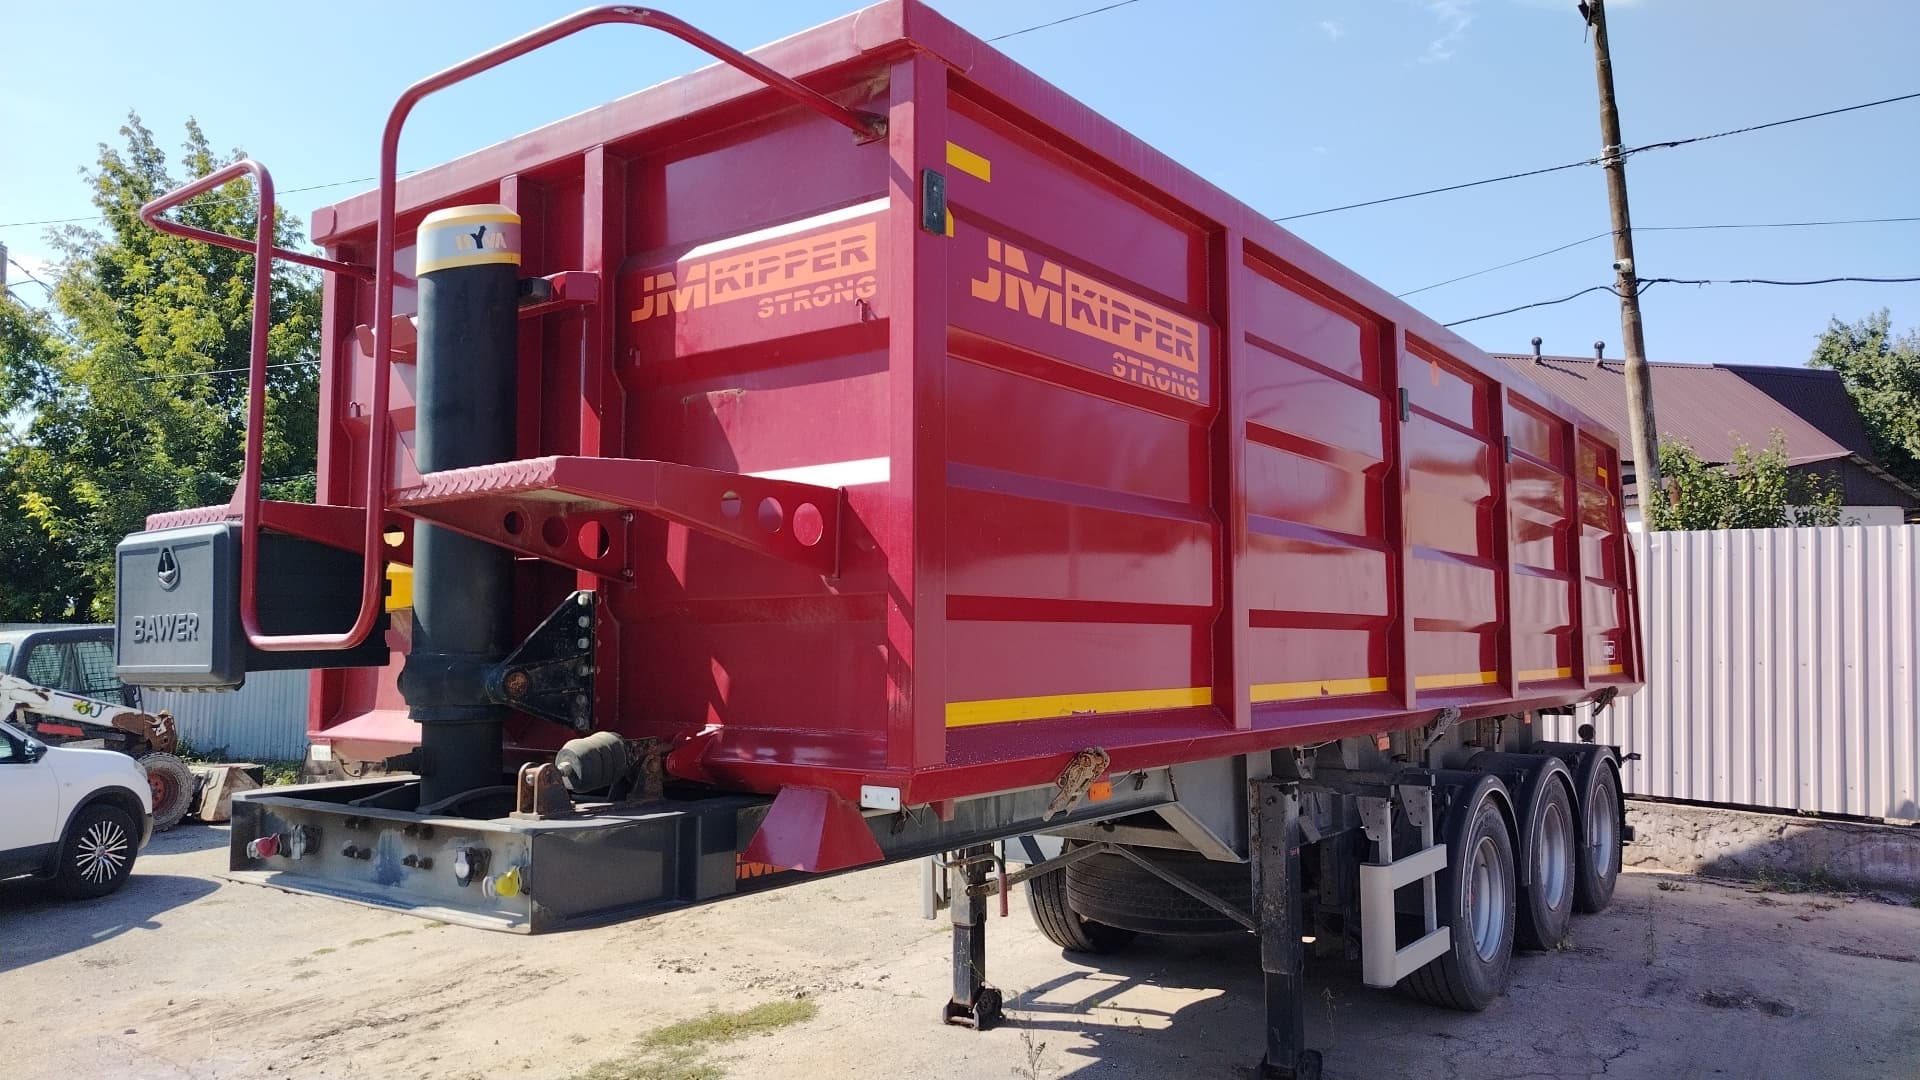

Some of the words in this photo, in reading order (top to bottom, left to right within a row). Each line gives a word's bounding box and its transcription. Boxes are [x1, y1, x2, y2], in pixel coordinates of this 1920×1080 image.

[758, 276, 877, 318] STRONG
[1112, 351, 1199, 399] STRONG
[133, 613, 199, 644] BAWER
